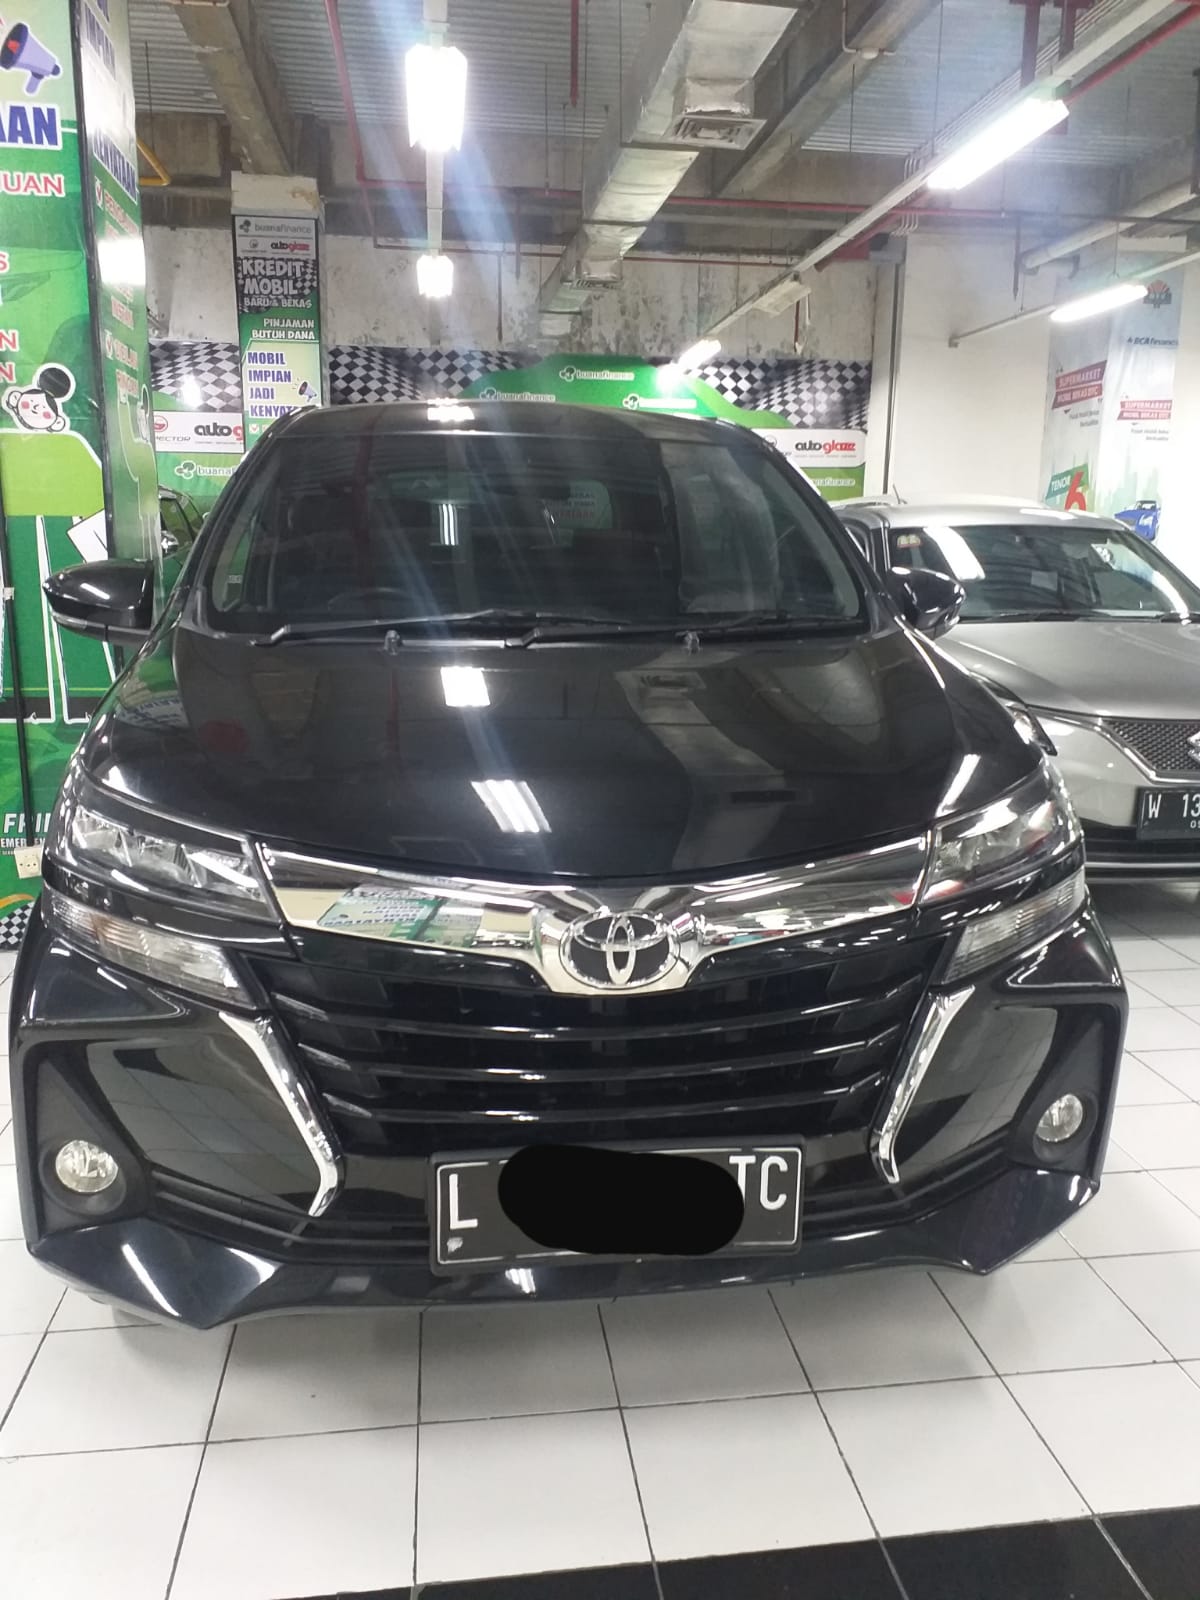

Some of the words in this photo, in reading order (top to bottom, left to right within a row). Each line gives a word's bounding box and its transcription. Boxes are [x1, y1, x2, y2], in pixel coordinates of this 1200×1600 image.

[0, 105, 58, 146] AN
[242, 259, 304, 278] KREDIT
[243, 278, 298, 295] MOBIL
[243, 297, 269, 307] BARU
[281, 298, 312, 308] BEKAS
[263, 318, 315, 329] PINJAMAN
[252, 329, 285, 339] BUTUH
[287, 331, 315, 340] DANA
[247, 352, 286, 365] MOBIL
[248, 369, 292, 383] IMPIAN
[249, 387, 275, 400] JADI
[795, 440, 856, 454] autoglaze
[1148, 793, 1162, 818] W
[449, 1173, 478, 1230] L
[728, 1154, 789, 1211] TC
